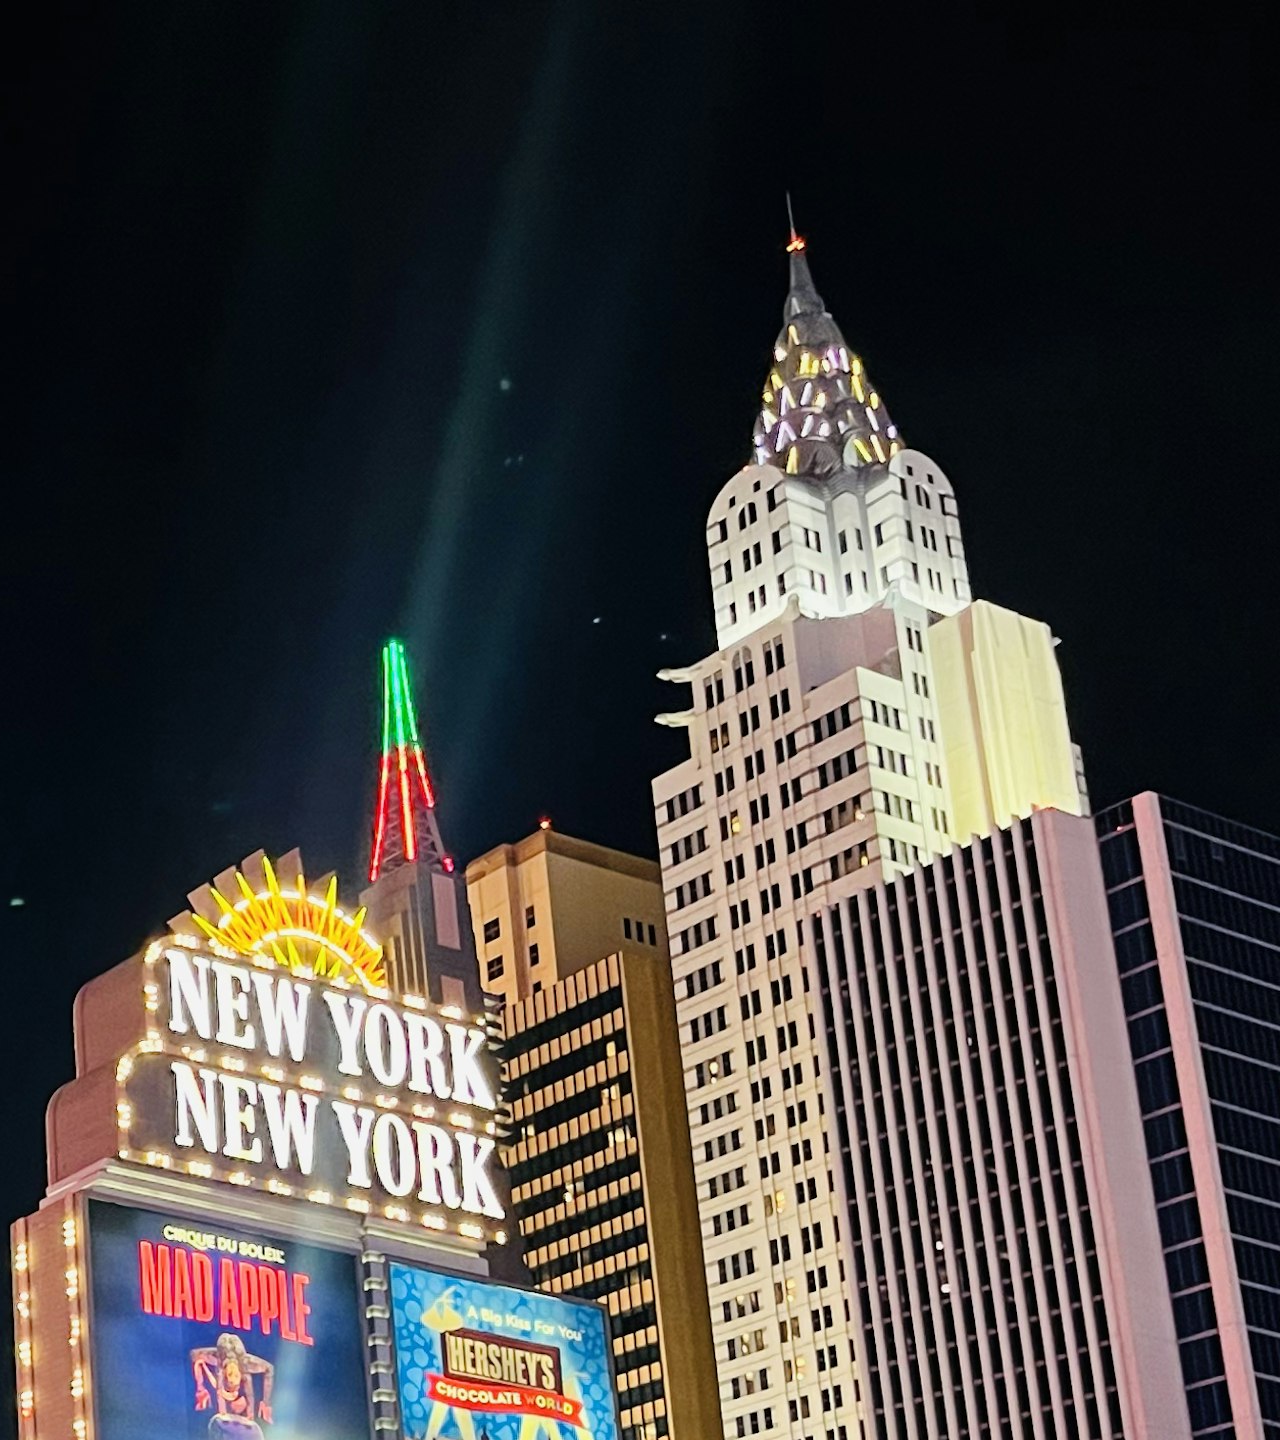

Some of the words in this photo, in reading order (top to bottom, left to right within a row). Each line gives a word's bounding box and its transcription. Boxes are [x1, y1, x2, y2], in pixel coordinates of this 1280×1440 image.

[164, 948, 311, 1062] NEW
[322, 990, 496, 1111] YORK
[171, 1060, 319, 1175] NEW
[331, 1099, 506, 1220] YORK
[163, 1225, 216, 1250] CIRQUE
[217, 1236, 237, 1254] DU
[239, 1241, 285, 1264] SOLEIL
[139, 1240, 214, 1322] MAD
[219, 1258, 314, 1346] APPLE
[466, 1305, 478, 1320] A
[534, 1320, 555, 1336] For
[449, 1333, 556, 1390] HERSHEY'S
[435, 1381, 522, 1405] CHOCOLATE
[525, 1394, 573, 1415] WORLD
